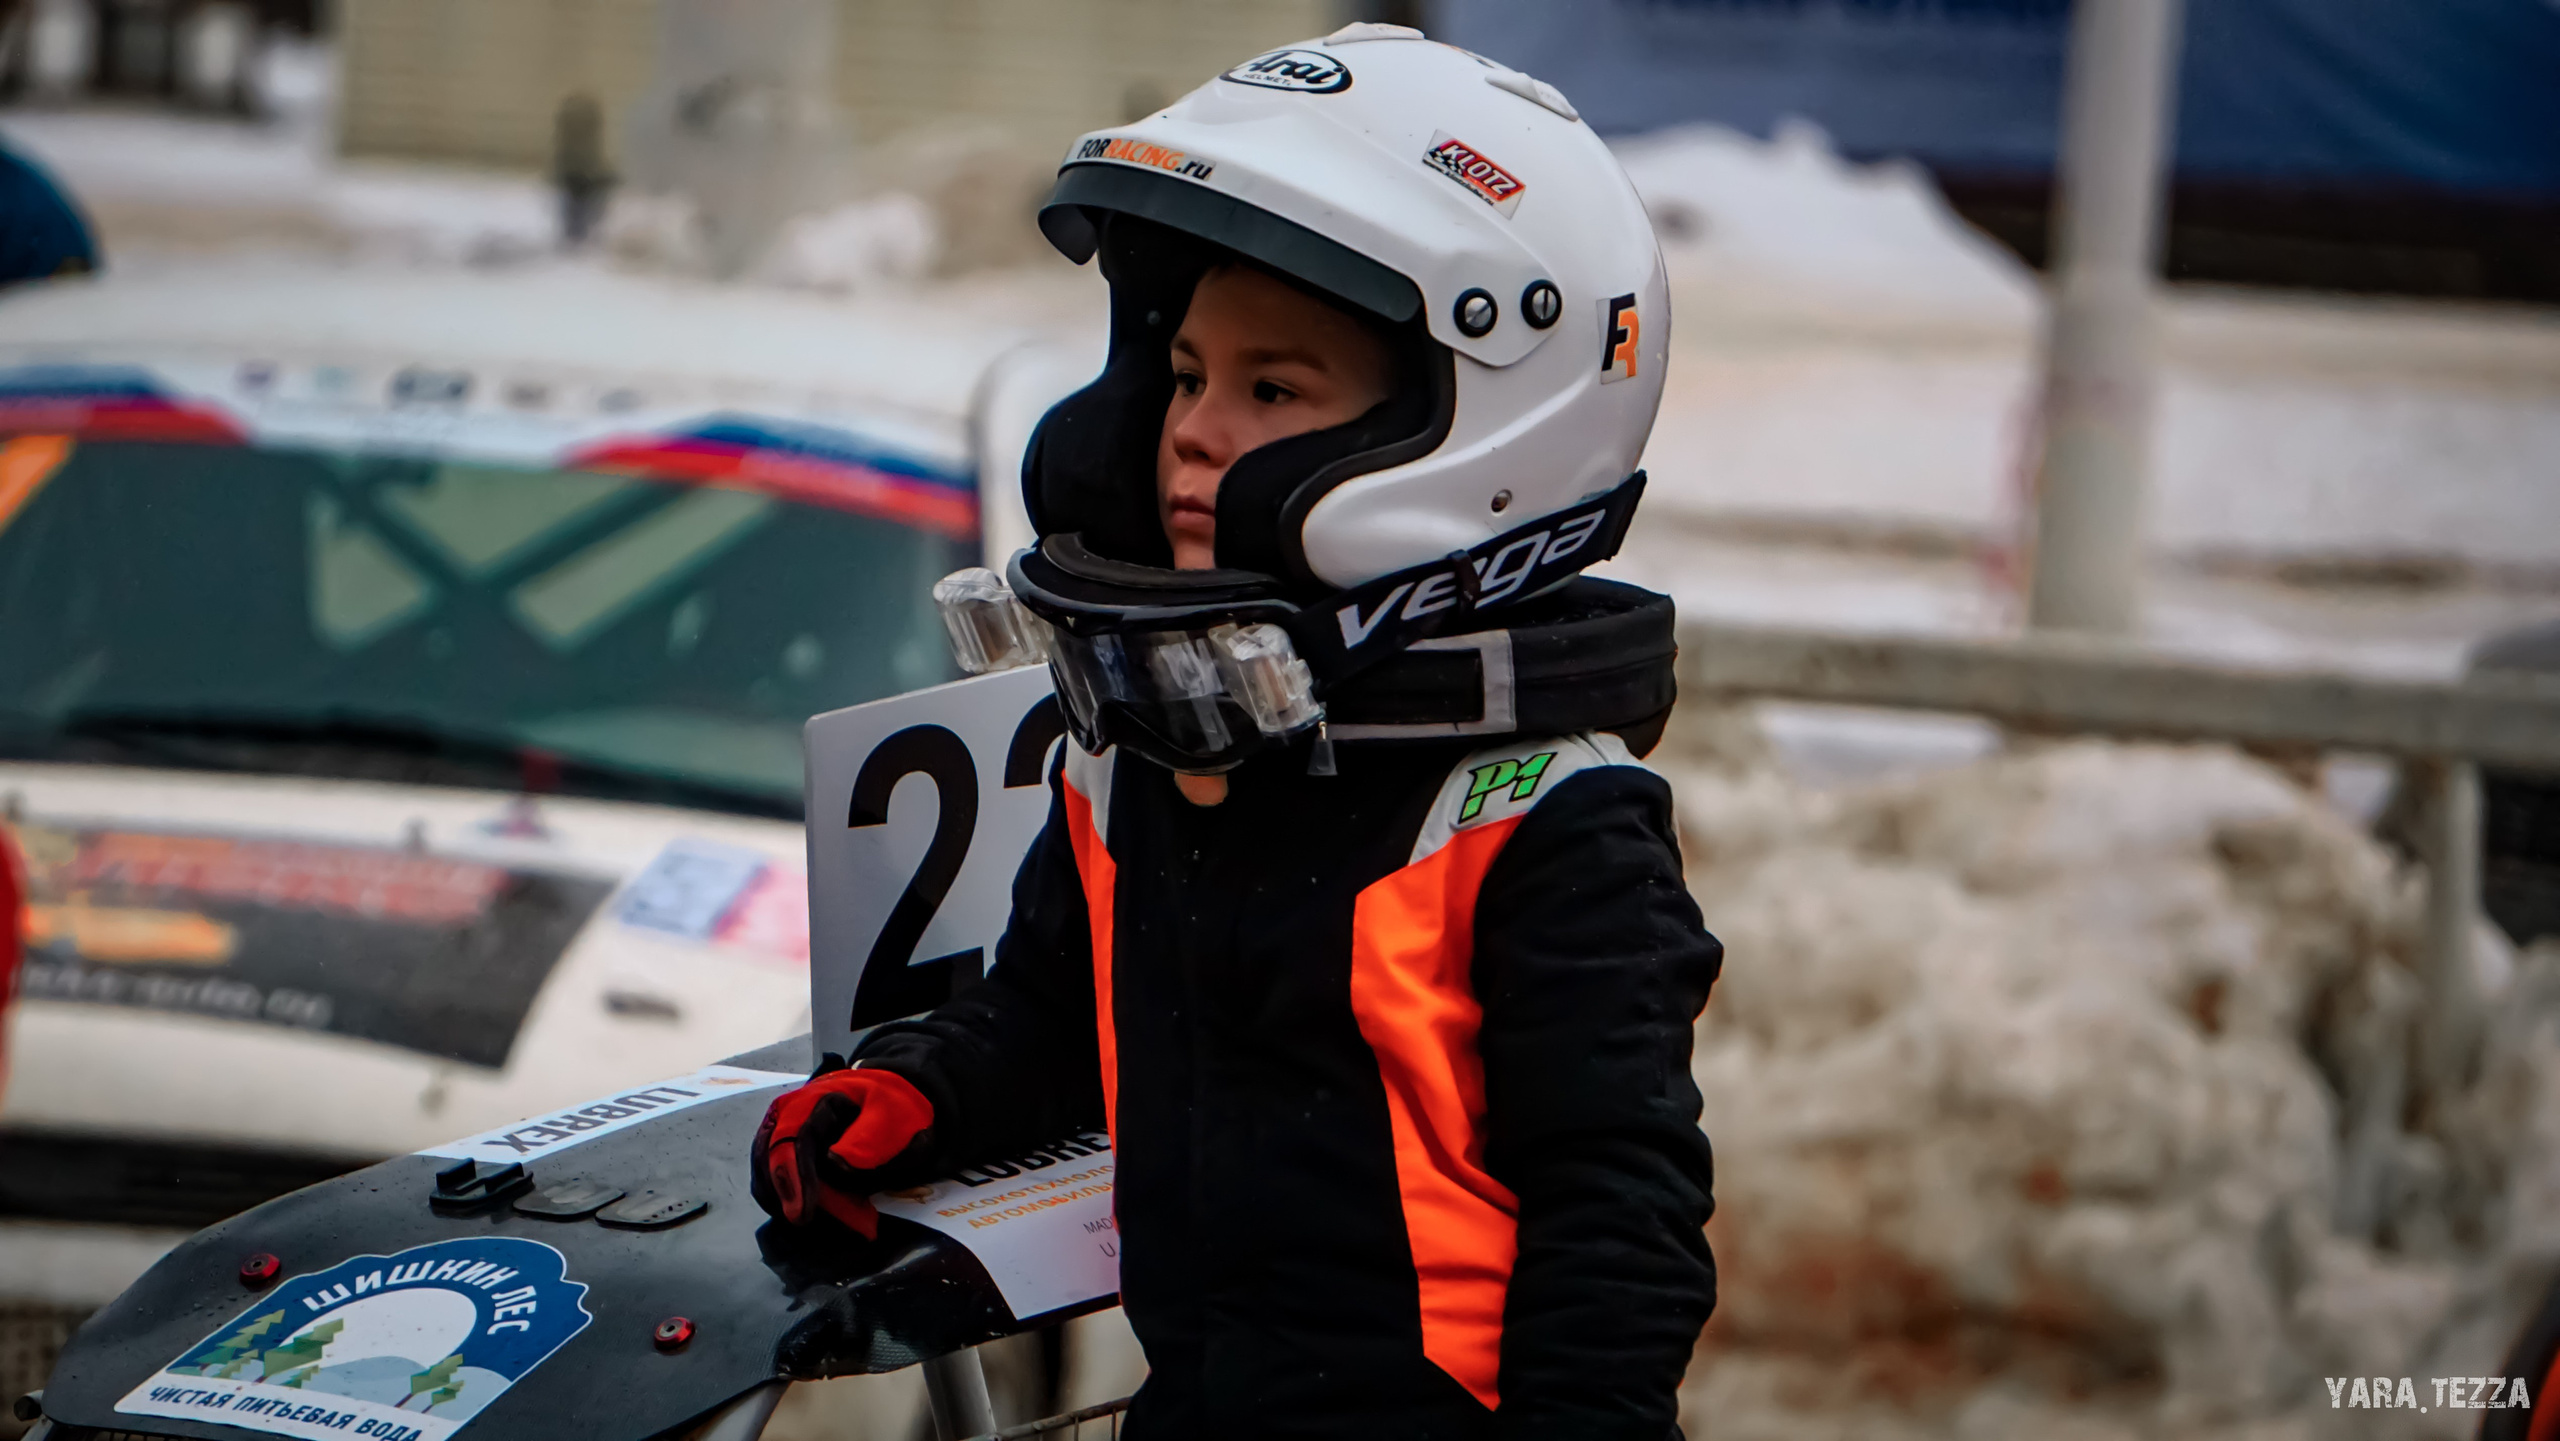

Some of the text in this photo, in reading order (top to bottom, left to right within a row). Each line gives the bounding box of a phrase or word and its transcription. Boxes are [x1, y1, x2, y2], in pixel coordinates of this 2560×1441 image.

[1248, 51, 1345, 84] Arai
[1077, 138, 1213, 180] FORRACING.ru
[1441, 144, 1517, 195] KLOTZ
[1457, 752, 1558, 825] P1
[481, 1087, 702, 1154] LUBREX
[1083, 1216, 1115, 1234] MAD
[303, 1260, 537, 1335] ШИШКИН ЛЕС
[149, 1387, 423, 1441] ЧИСТАЯ ПИТЬЕВАЯ ВОДА
